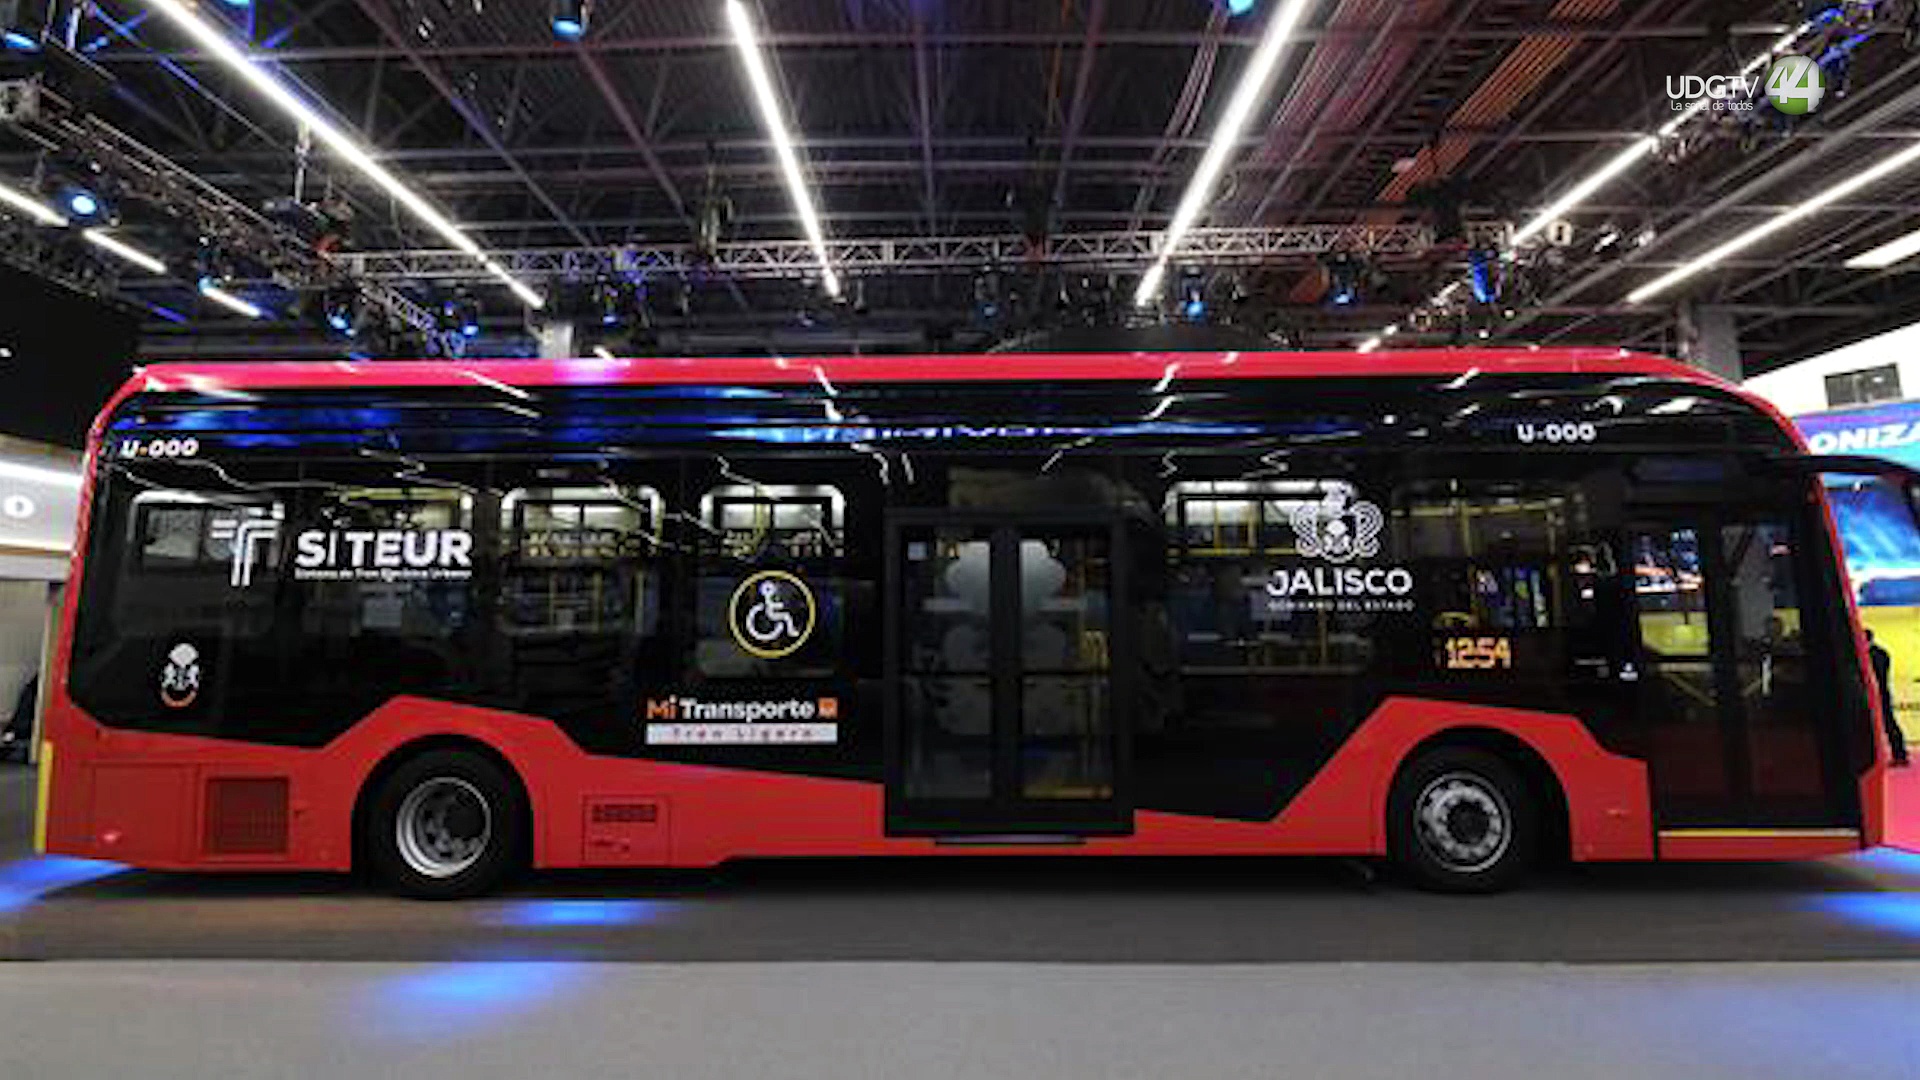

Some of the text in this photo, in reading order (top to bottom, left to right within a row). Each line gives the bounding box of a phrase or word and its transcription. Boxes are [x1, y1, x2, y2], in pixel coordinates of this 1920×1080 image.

[295, 529, 473, 567] SITEUR
[1266, 566, 1413, 597] JALISCO
[647, 695, 815, 723] Mi Transporte
